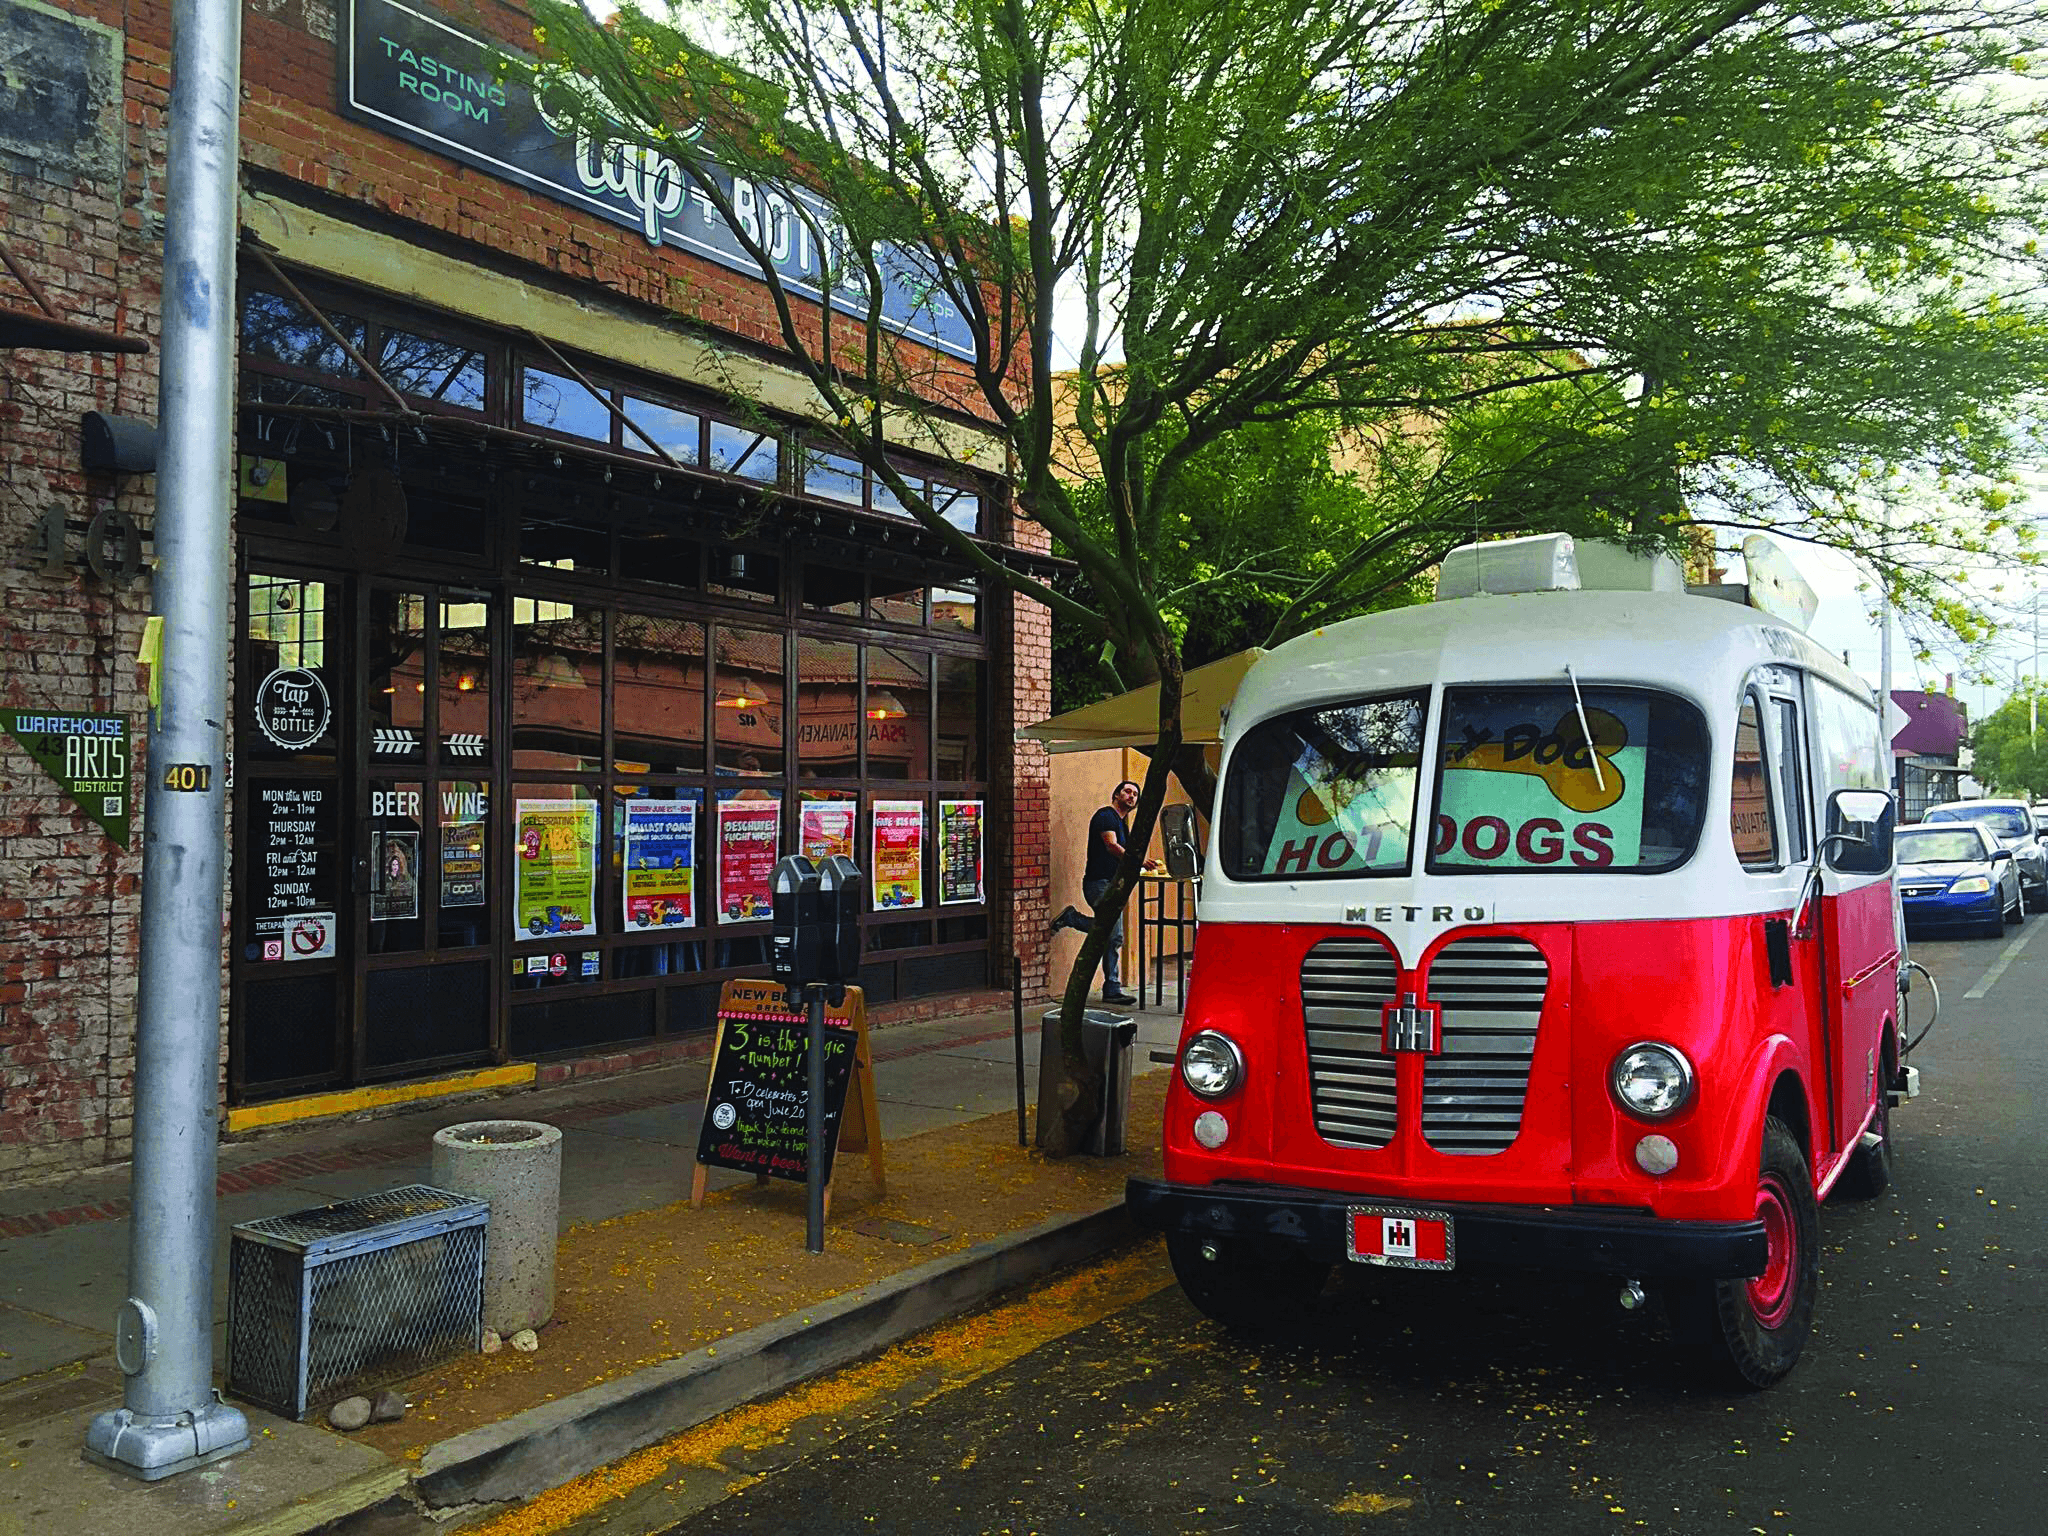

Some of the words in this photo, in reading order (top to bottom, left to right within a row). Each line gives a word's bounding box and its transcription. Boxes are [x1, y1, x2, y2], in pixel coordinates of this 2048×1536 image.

[379, 37, 507, 107] TASTING
[400, 71, 490, 124] ROOM
[273, 680, 314, 708] Tap
[16, 716, 124, 736] WAREHOUSE
[272, 717, 315, 732] BOTTLE
[36, 737, 64, 756] 43
[65, 735, 125, 778] ARTS
[165, 767, 209, 789] 401
[73, 781, 124, 793] DISTRICT
[262, 790, 284, 802] MON
[302, 790, 322, 801] WED
[372, 791, 420, 816] BEER
[442, 791, 486, 815] WINE
[272, 803, 288, 814] 2PM
[297, 803, 315, 814] 11PM
[269, 821, 316, 833] THURSDAY
[522, 816, 575, 825] CELEBRATING
[270, 834, 286, 846] 2PM
[294, 834, 314, 845] 12AM
[1275, 824, 1391, 874] HOT
[266, 853, 281, 864] FRI
[301, 852, 318, 863] SAT
[268, 866, 288, 877] 12PM
[297, 865, 316, 876] 12AM
[273, 882, 310, 895] SUNDAY
[267, 896, 287, 908] 12PM
[296, 896, 316, 907] 10PM
[1345, 905, 1485, 922] METRO
[731, 988, 768, 1001] NEW
[729, 1023, 750, 1051] 3
[758, 1034, 772, 1049] is
[777, 1028, 799, 1052] the
